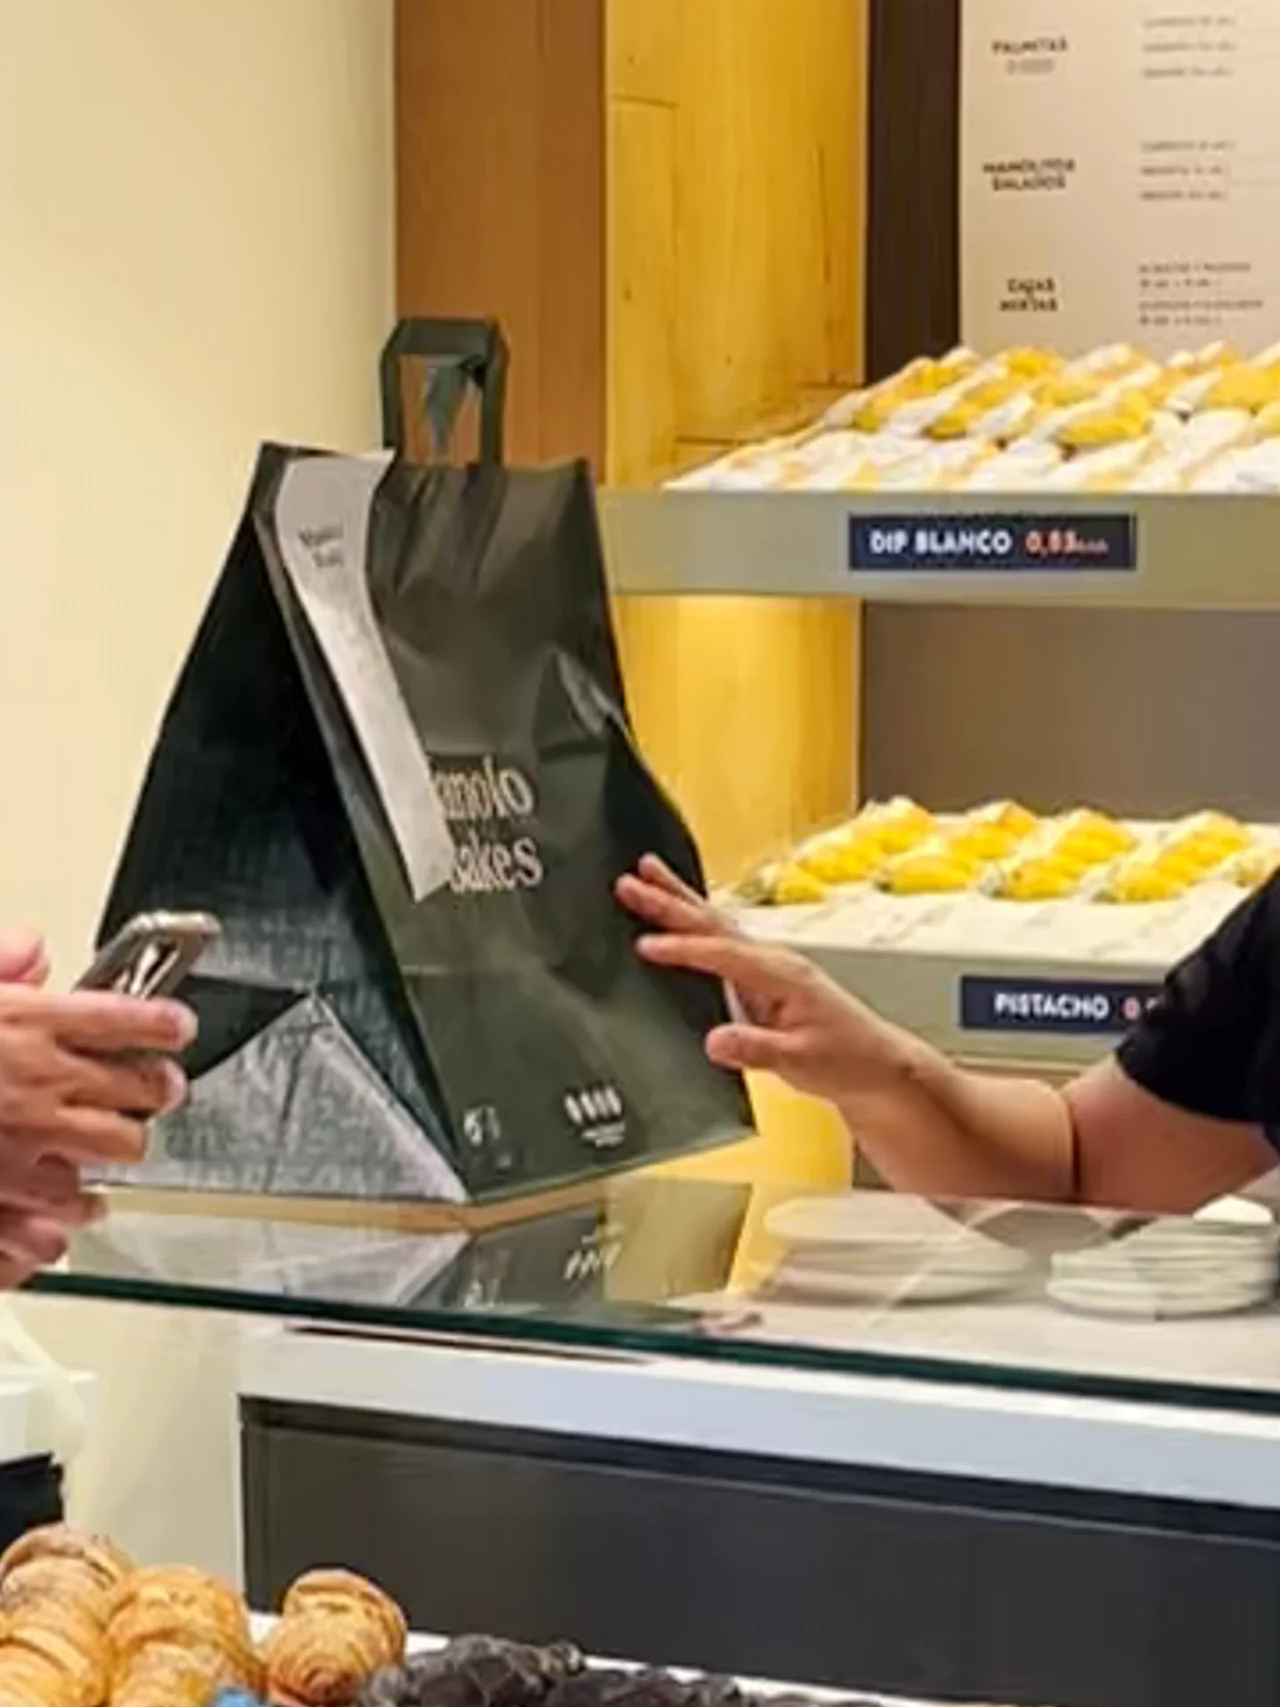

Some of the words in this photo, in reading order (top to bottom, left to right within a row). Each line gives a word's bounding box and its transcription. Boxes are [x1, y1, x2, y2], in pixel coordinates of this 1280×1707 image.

[870, 529, 909, 555] DIP
[914, 529, 1014, 555] BLANCO
[993, 992, 1111, 1021] PISTACHO
